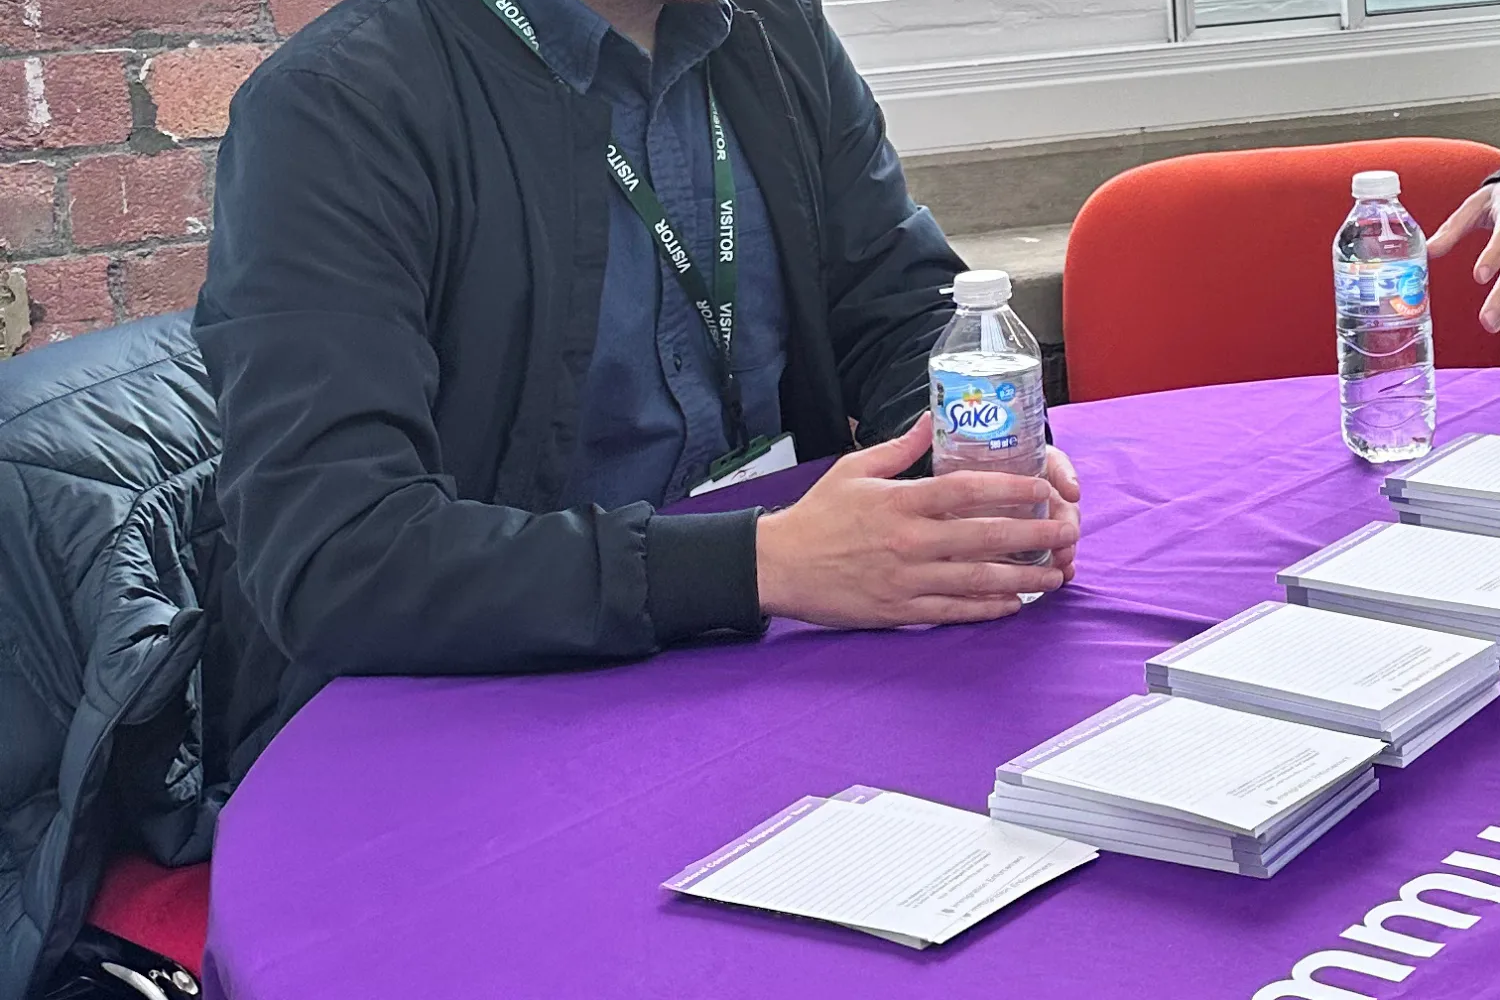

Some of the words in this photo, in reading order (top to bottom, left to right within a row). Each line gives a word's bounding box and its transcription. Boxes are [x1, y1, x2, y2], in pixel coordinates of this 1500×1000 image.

[606, 144, 640, 193] VISITO
[654, 218, 692, 274] VISITOR
[720, 199, 734, 263] VISITOR
[719, 302, 733, 352] VISIT
